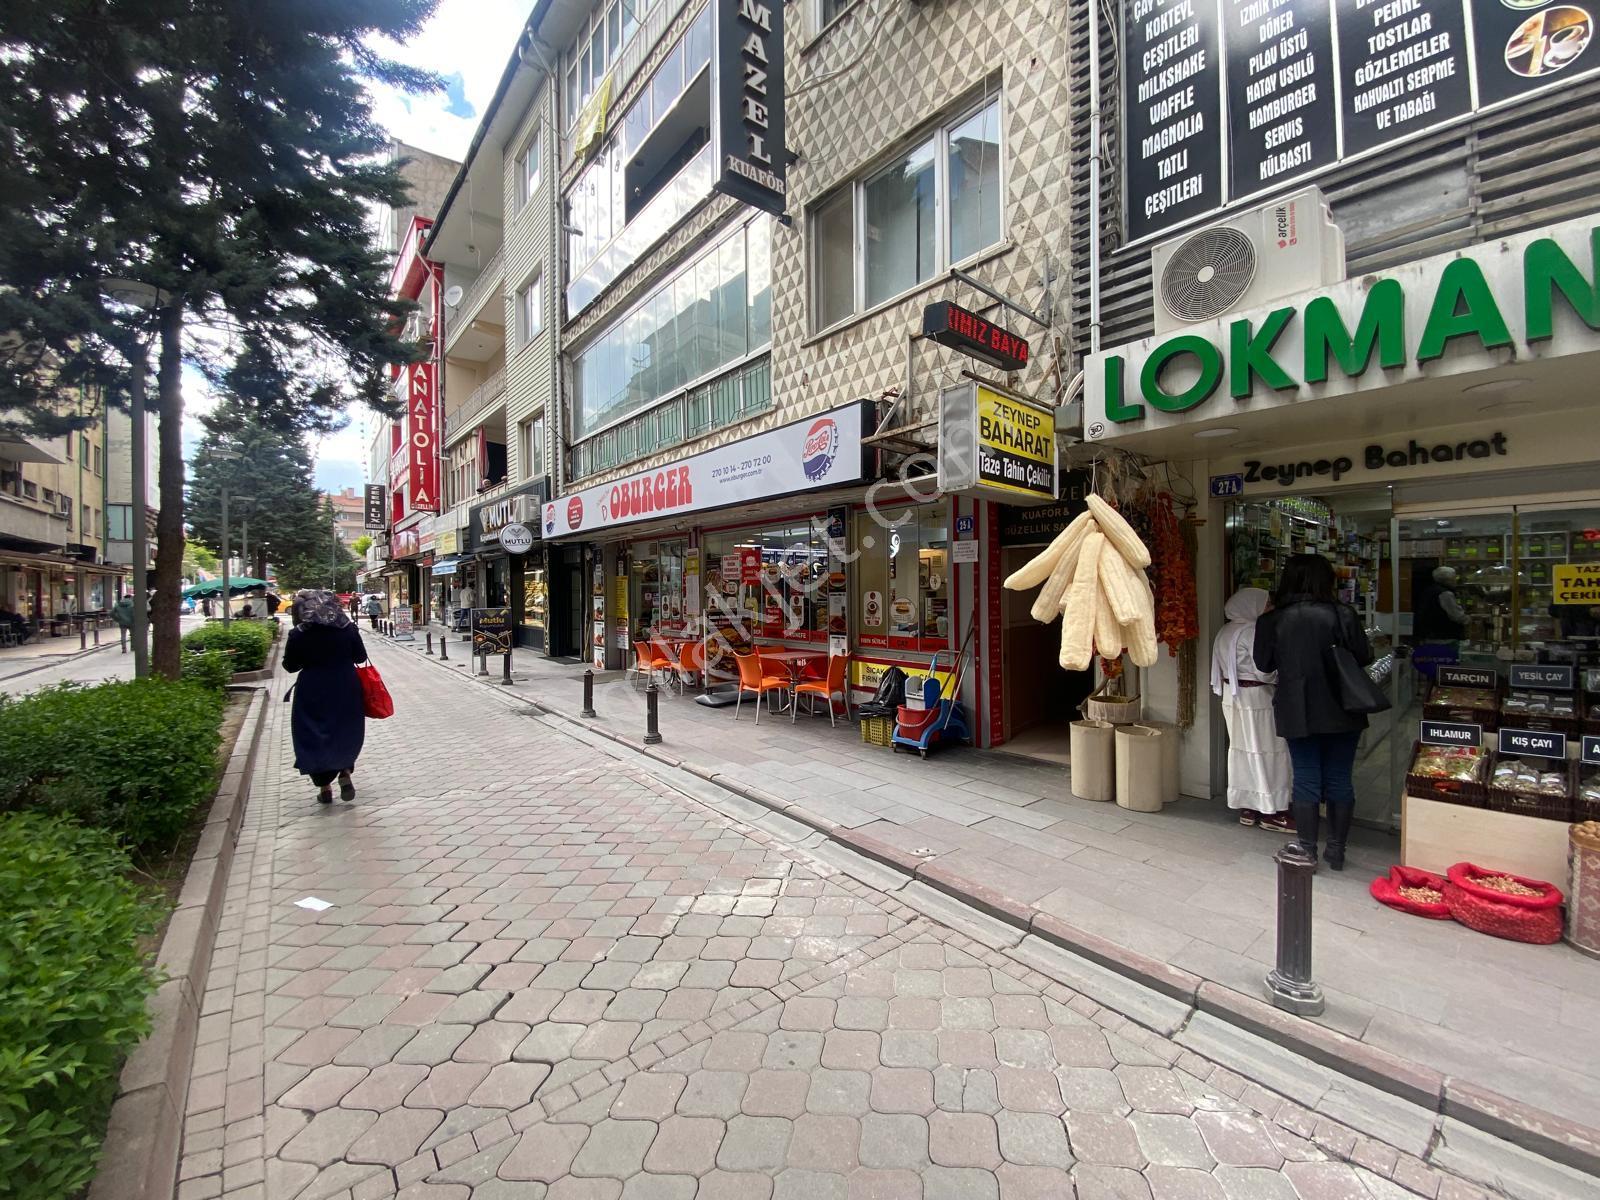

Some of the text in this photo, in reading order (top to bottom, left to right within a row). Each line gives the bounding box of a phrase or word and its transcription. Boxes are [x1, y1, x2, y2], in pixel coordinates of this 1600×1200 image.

[1145, 0, 1194, 42] KOKTEYL
[1259, 10, 1294, 43] DÖNER
[1367, 12, 1432, 55] TOSTLAR
[1280, 27, 1308, 60] ÜSTÜ
[1354, 32, 1450, 87] GÖZLEMELER
[1138, 50, 1206, 103] MİLKSHAKE
[1246, 52, 1315, 104] HATAY USULÜ
[1354, 56, 1456, 114] KAHVALTI SERPME
[1150, 85, 1195, 125] WAFFLE
[1249, 83, 1317, 130] HAMBURGER
[1376, 90, 1436, 130] VE TABAĞI
[728, 154, 785, 195] KUAFÖR
[1158, 149, 1188, 180] TATLI
[1260, 141, 1312, 181] KÜLBASTI
[1145, 174, 1203, 219] ÇEŞİTLERİ
[1276, 207, 1289, 238] arçelik
[1105, 226, 1600, 423] LOKMAN
[993, 401, 1041, 429] ZEYNEP
[980, 416, 1051, 458] BAHARAT
[980, 452, 1001, 475] Taze
[1003, 457, 1025, 482] Tahin
[1244, 432, 1507, 486] Zeynep Baharat
[610, 465, 692, 520] OBURGER
[504, 537, 531, 546] MUTLU
[1445, 673, 1489, 684] TARÇIN
[1545, 672, 1563, 682] ÇAY
[1430, 728, 1471, 740] IHLAMUR
[1511, 737, 1552, 749] KIŞ ÇAYI
